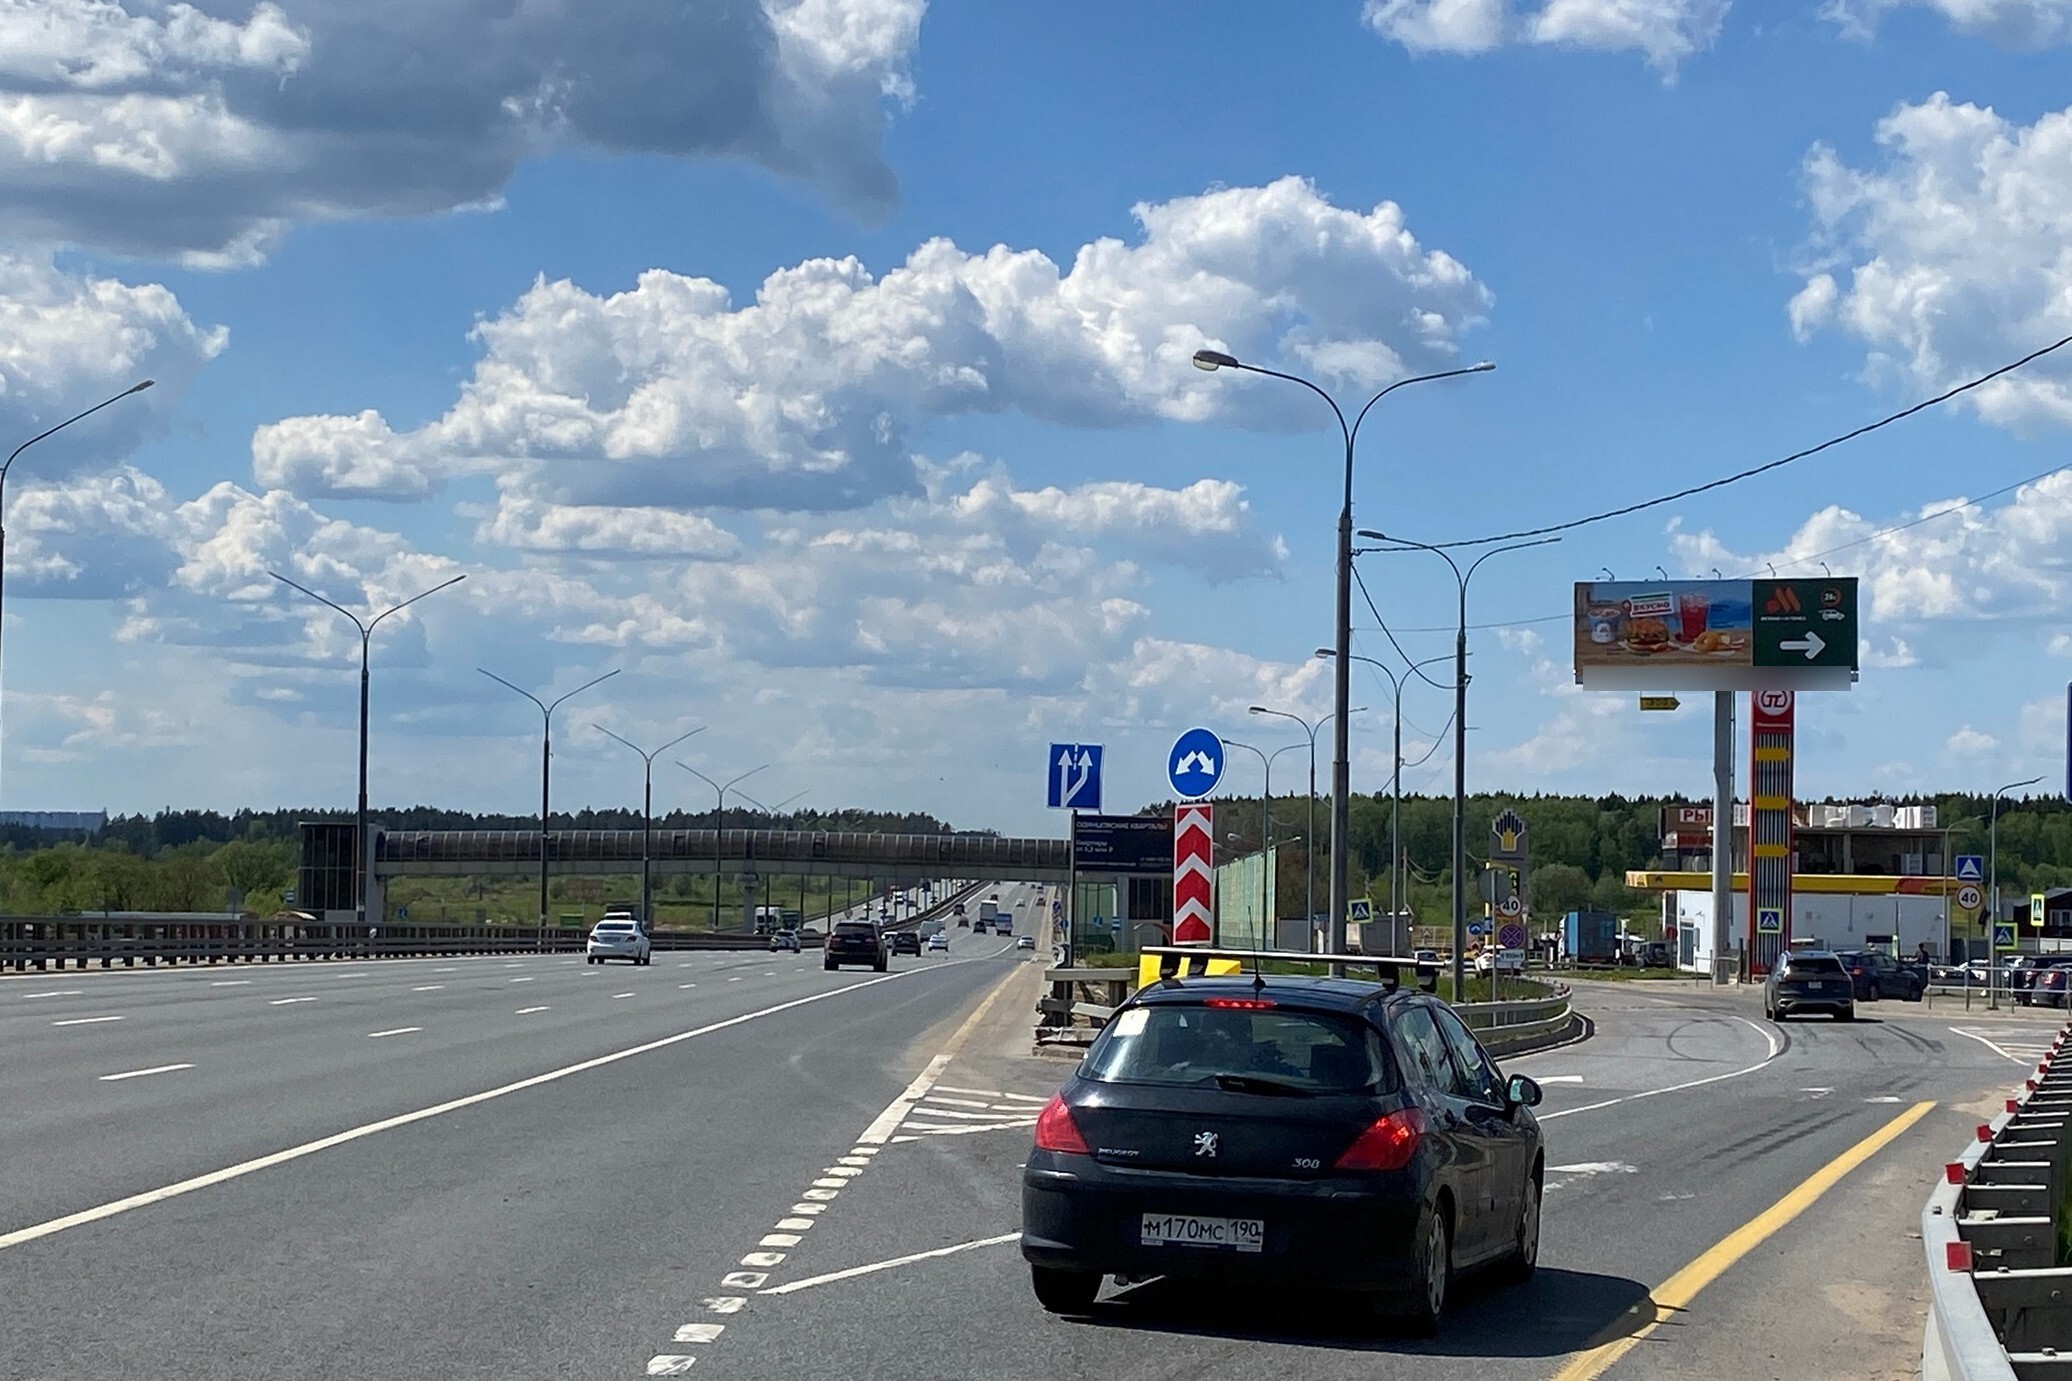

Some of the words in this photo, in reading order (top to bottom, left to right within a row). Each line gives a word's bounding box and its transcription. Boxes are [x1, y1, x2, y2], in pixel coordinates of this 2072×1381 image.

[1633, 601, 1670, 611] ВКУСНО
[1683, 810, 1709, 821] РЫ
[1960, 892, 1977, 903] 40
[1503, 900, 1518, 911] 40
[1292, 1158, 1320, 1169] 308
